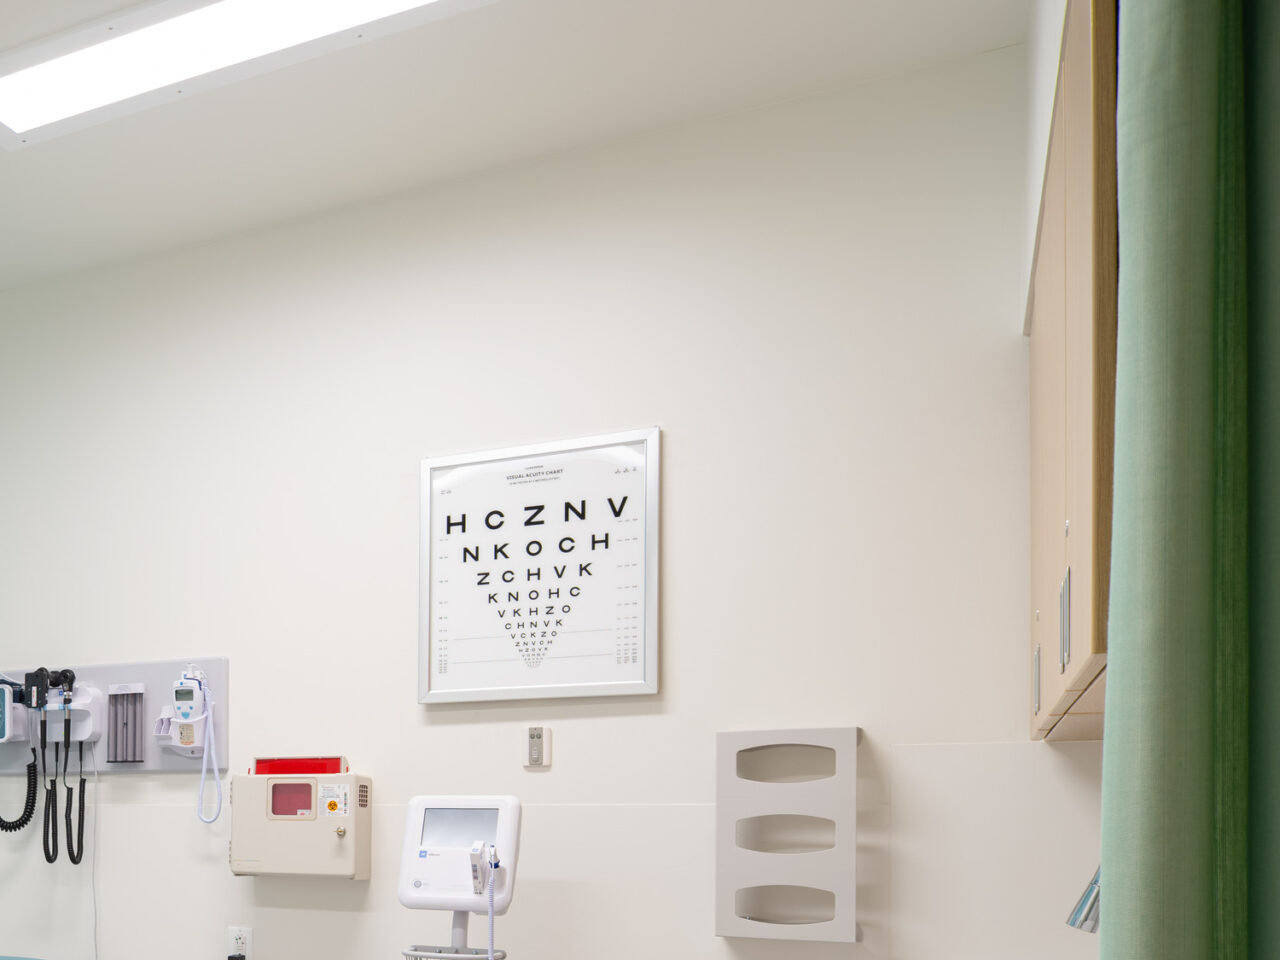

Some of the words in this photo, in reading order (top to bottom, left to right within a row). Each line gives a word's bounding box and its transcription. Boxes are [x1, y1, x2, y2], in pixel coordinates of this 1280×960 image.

[446, 513, 466, 535] H
[484, 510, 504, 530] C
[523, 504, 545, 526] Z
[564, 499, 586, 522] N
[607, 495, 628, 518] V
[463, 546, 479, 563] N
[493, 543, 510, 560] K
[525, 540, 542, 556] O
[558, 536, 575, 553] C
[591, 532, 609, 550] H
[477, 572, 490, 586] Z
[501, 570, 514, 583] C
[527, 567, 540, 581] H
[553, 565, 566, 578] V
[579, 562, 592, 576] K
[488, 593, 498, 604] K
[508, 591, 518, 602] N
[528, 589, 539, 600] O
[548, 587, 560, 599] H
[569, 586, 580, 597] C
[497, 609, 506, 618] V
[513, 608, 521, 617] K
[529, 607, 538, 616] H
[545, 605, 554, 615] Z
[561, 604, 570, 613] O
